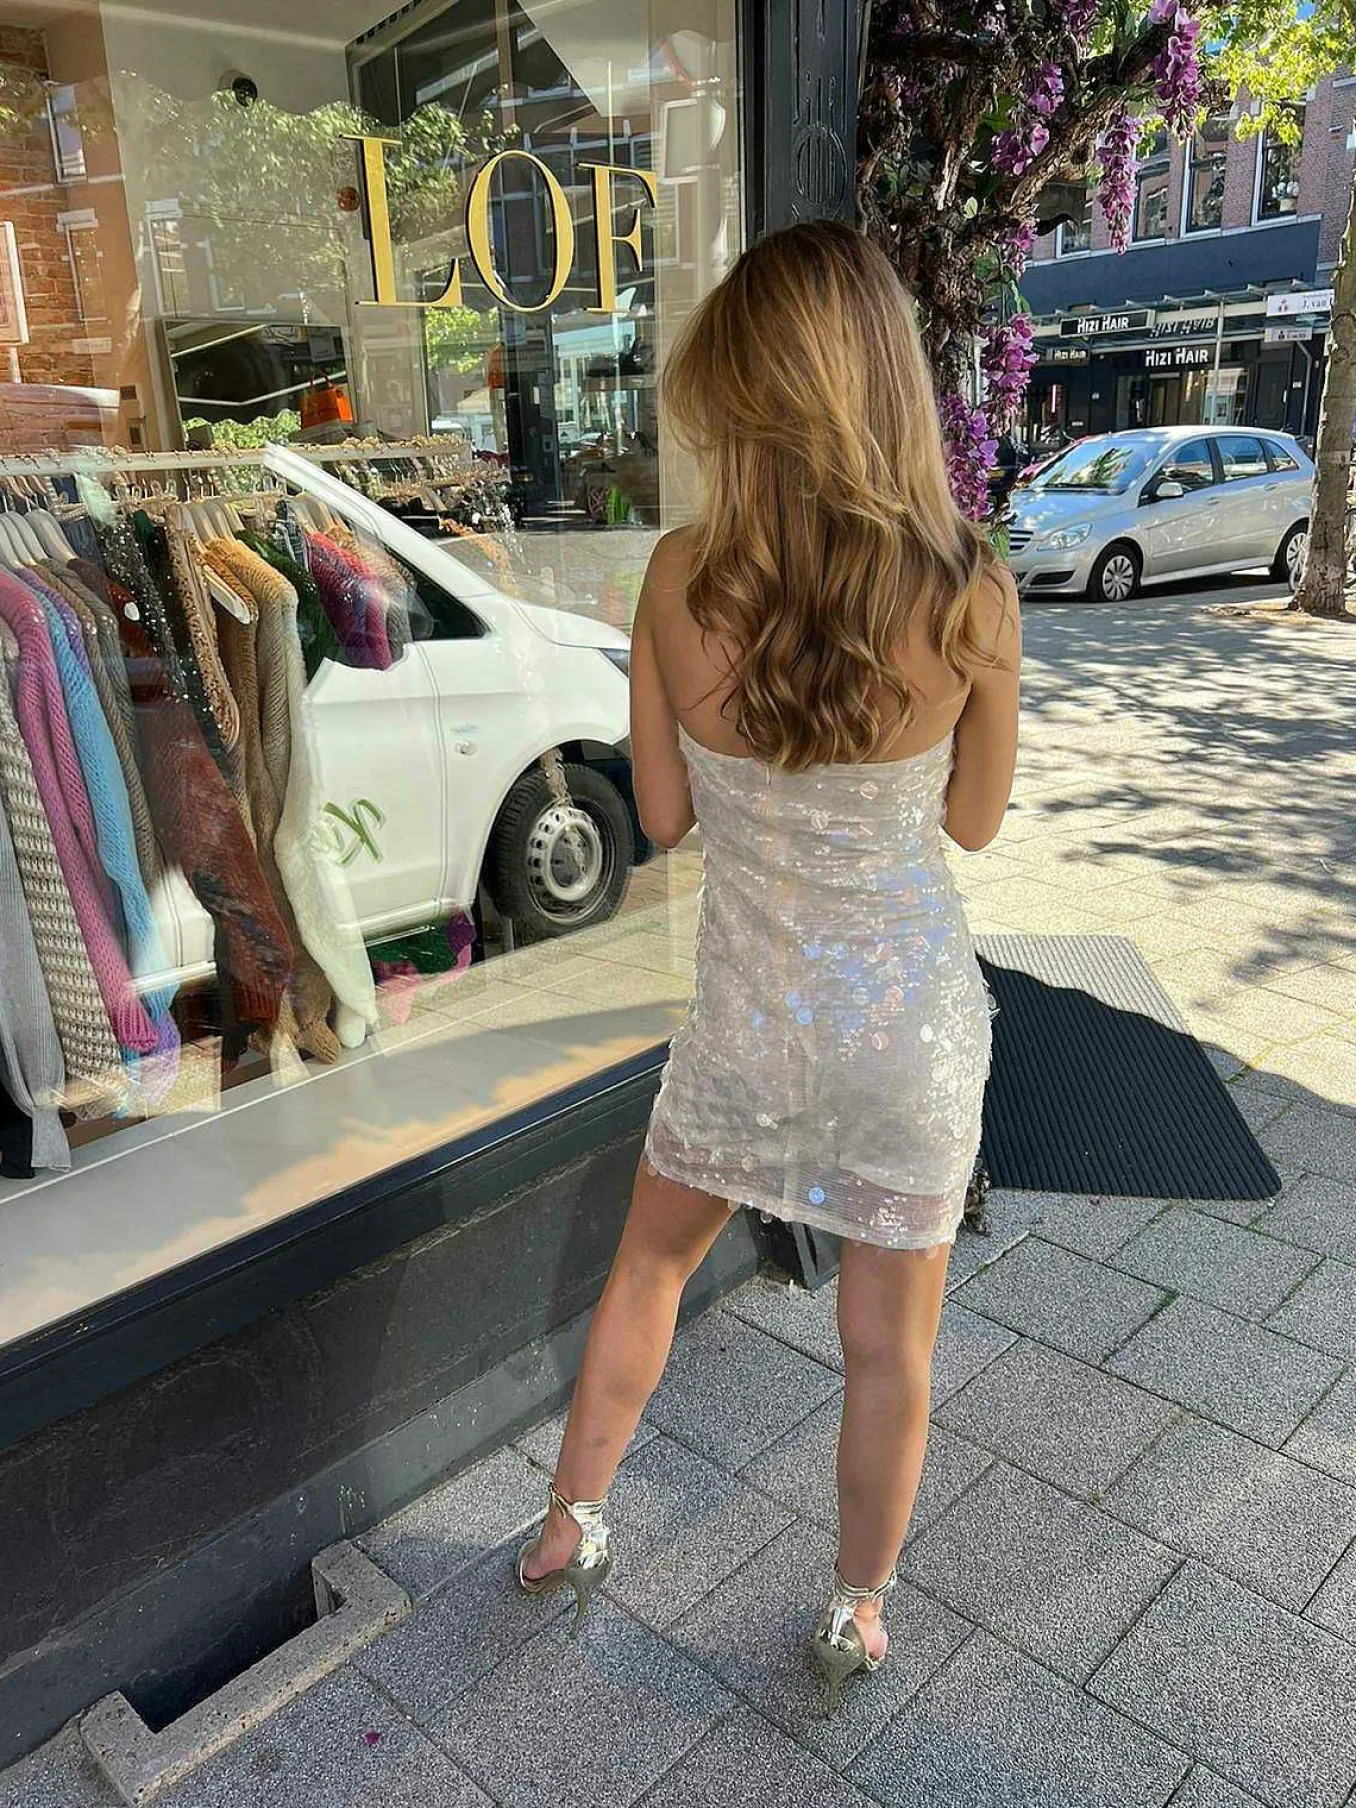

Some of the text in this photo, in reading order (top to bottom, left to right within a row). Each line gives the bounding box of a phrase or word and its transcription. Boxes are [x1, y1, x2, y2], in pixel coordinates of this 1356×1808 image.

[341, 134, 657, 314] LOF
[1077, 315, 1129, 334] HIZI HAIR
[1145, 348, 1208, 367] HIZI HAIR
